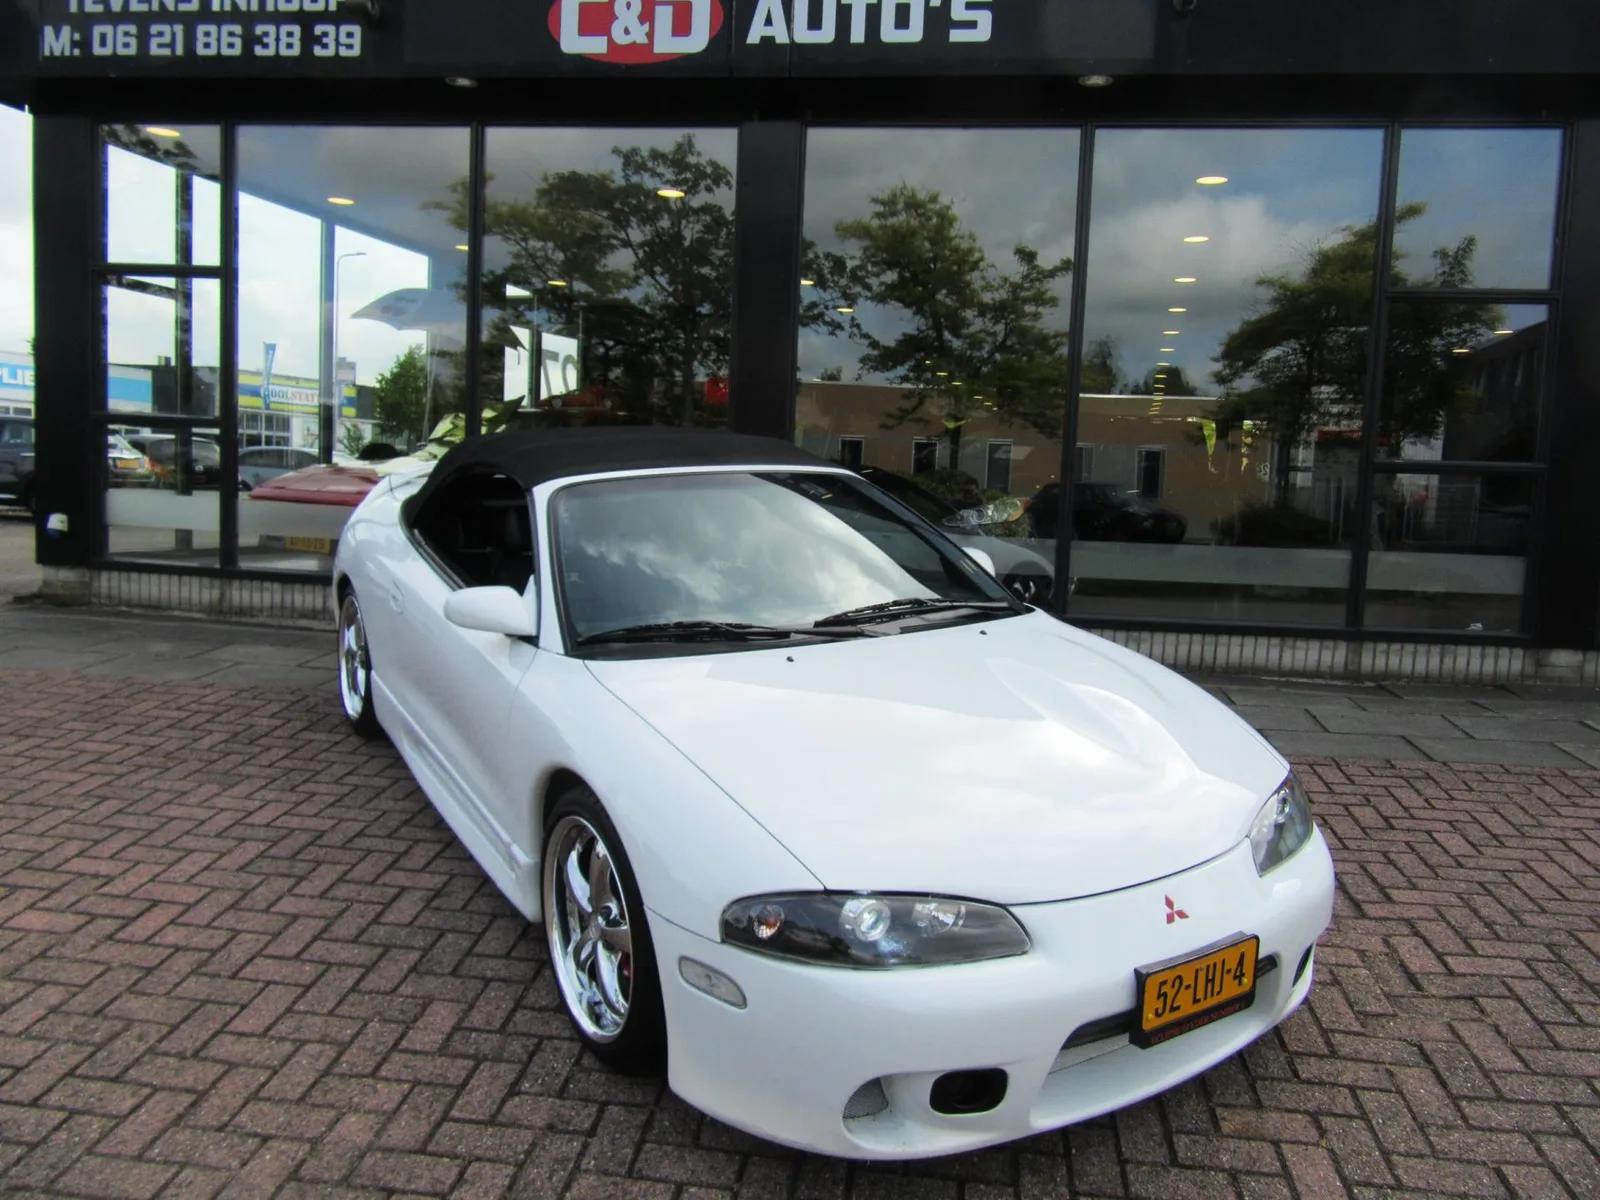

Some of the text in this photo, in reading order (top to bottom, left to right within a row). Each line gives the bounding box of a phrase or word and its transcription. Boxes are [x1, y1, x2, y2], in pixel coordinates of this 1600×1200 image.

[43, 24, 362, 57] M: 06 21 86 38 39
[560, 0, 711, 54] C&D
[1154, 951, 1246, 1018] 52-LHJ-4
